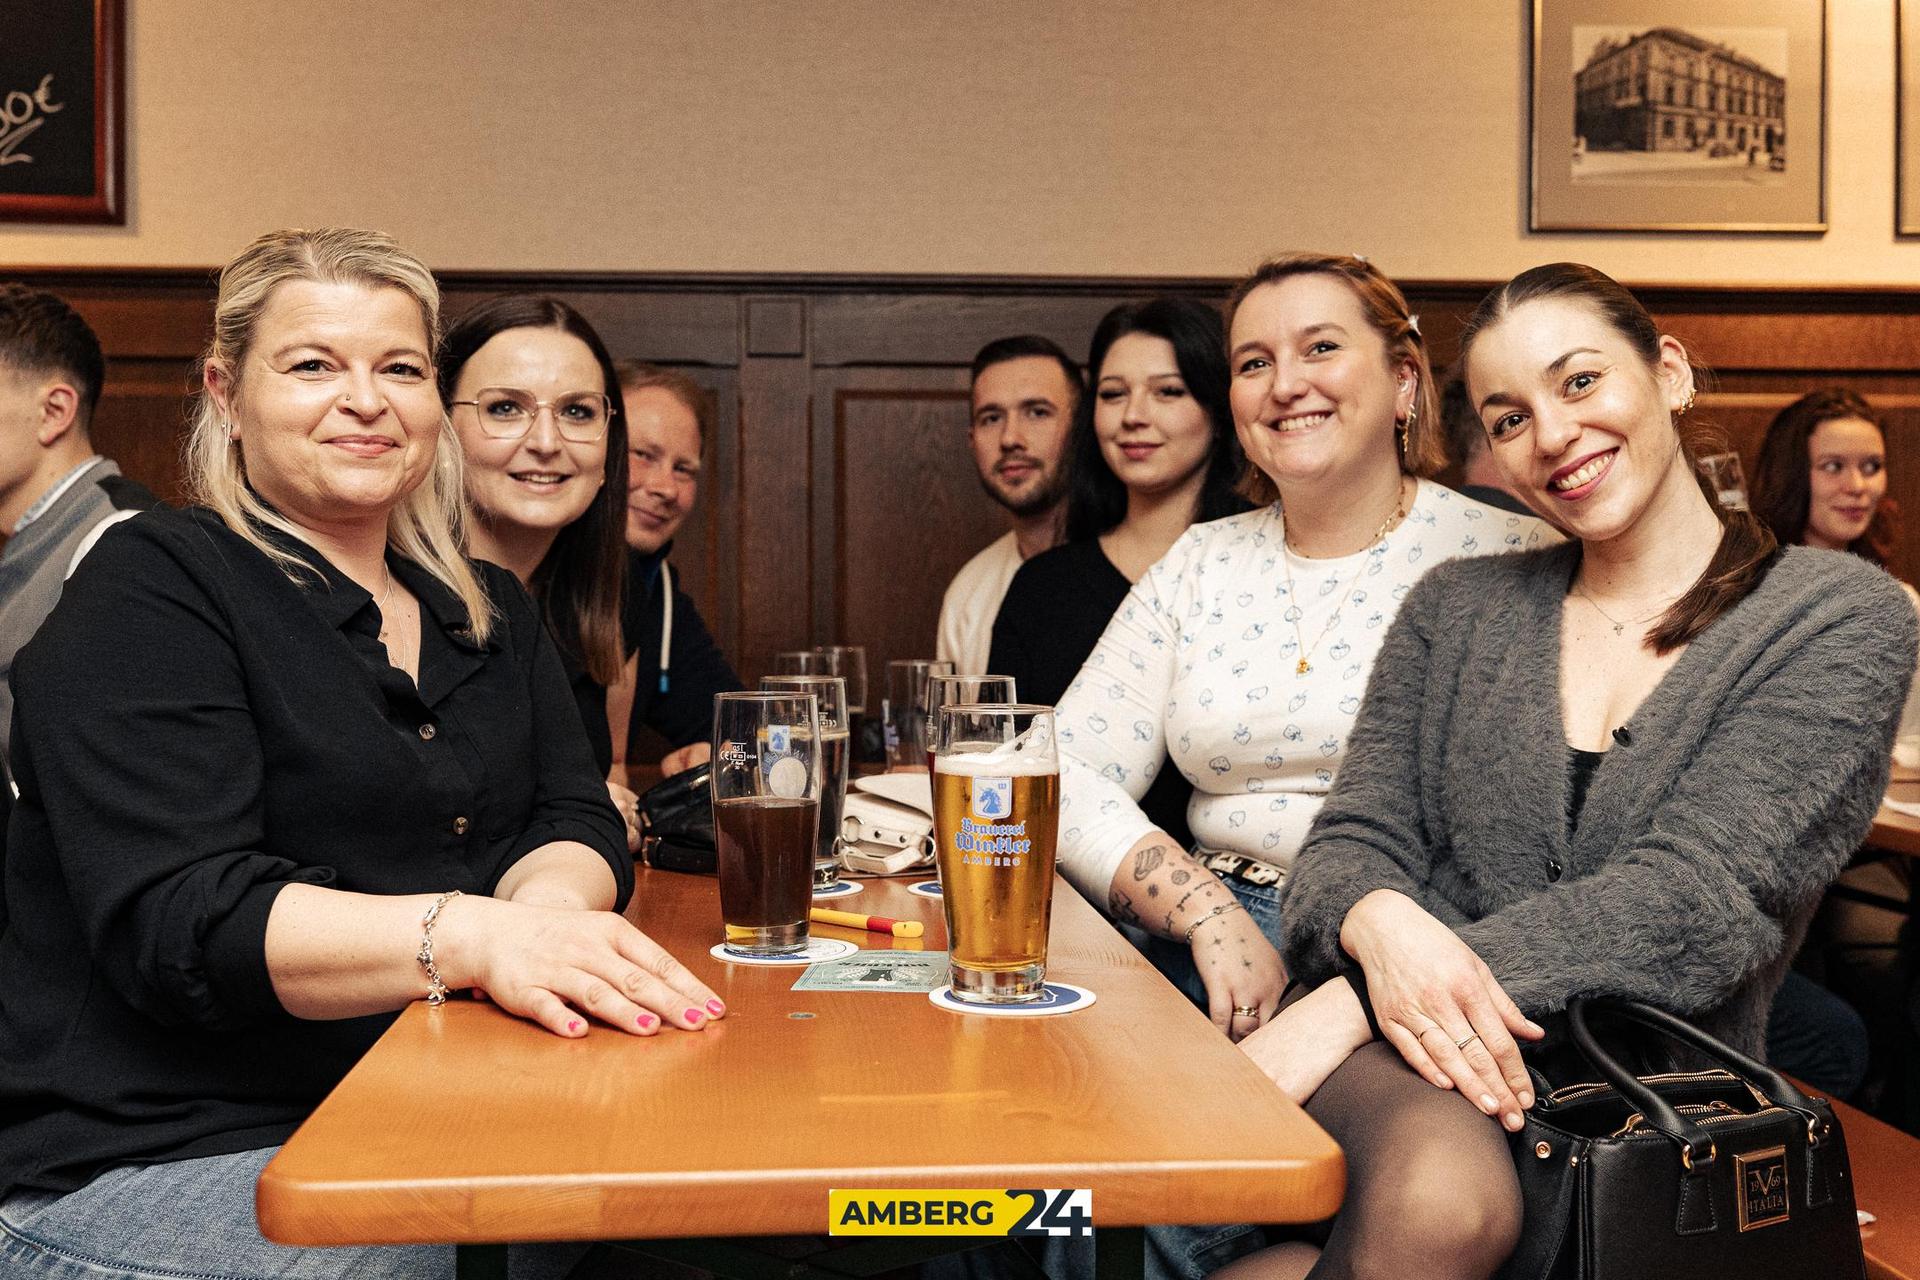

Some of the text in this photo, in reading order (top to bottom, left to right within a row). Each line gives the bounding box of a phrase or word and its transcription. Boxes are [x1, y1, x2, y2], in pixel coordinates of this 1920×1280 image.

[961, 817, 1026, 835] Brauerei
[955, 832, 1031, 854] Winkler
[961, 854, 1022, 867] AMBERG
[1749, 1196, 1784, 1213] ITALIA
